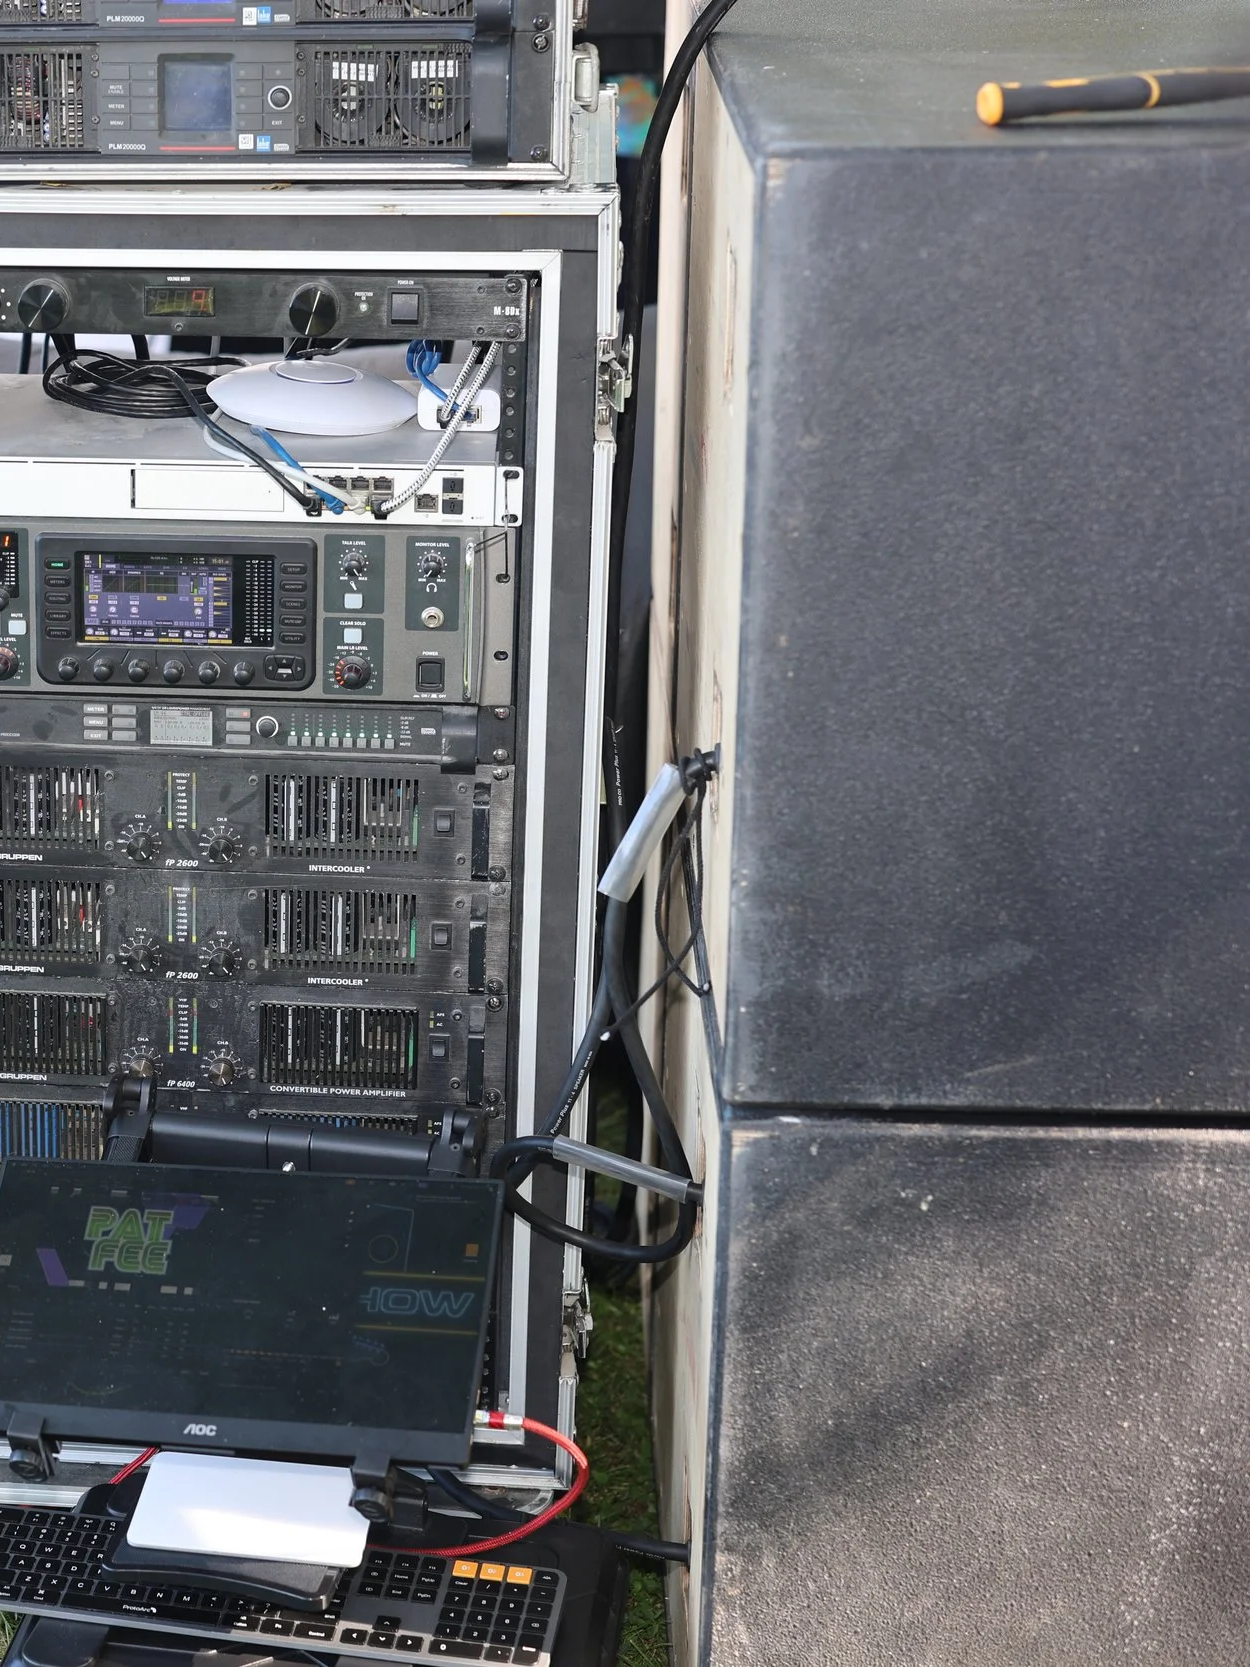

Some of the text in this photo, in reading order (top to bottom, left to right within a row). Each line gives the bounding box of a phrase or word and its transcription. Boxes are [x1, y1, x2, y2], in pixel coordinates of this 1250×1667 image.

[309, 865, 364, 873] INTERCOOLER
[307, 977, 363, 986] INTERCOOLER
[270, 1085, 328, 1094] CONVERTIBLE
[330, 1088, 361, 1096] POWER
[550, 1069, 585, 1134] Power Plus SPEAKER
[183, 1423, 217, 1436] AOC
[123, 1604, 150, 1612] ProtoArc
